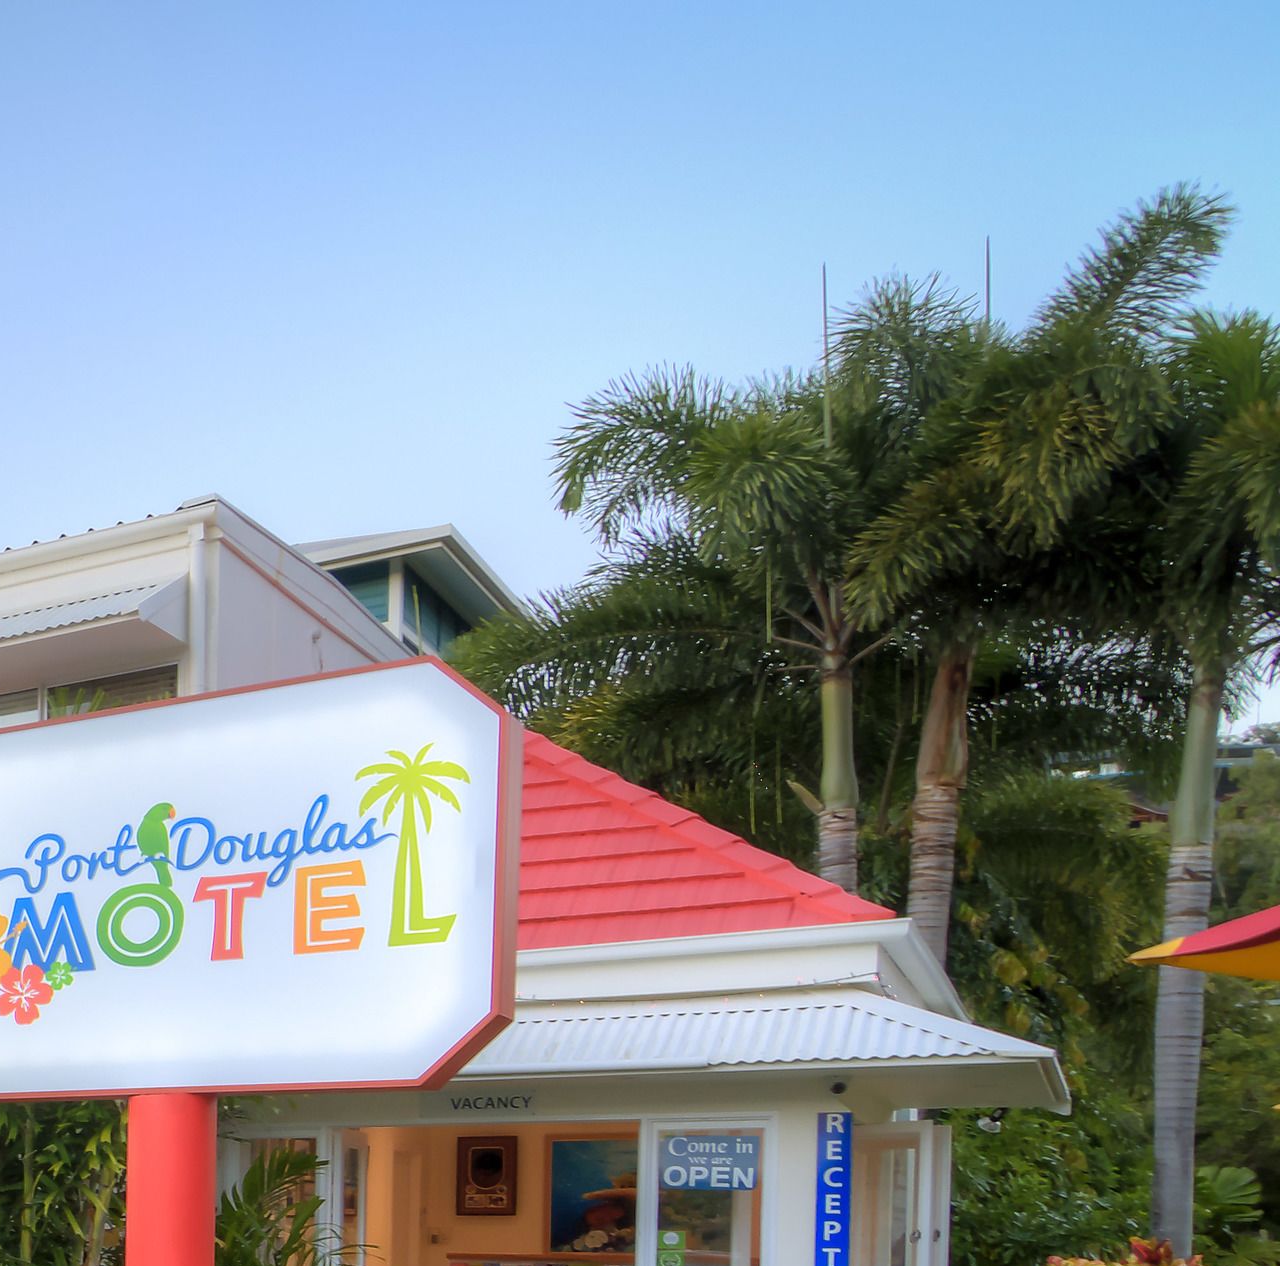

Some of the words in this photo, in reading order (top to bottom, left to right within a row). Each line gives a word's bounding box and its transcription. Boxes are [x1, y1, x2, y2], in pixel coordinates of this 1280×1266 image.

[169, 794, 397, 886] Douglas
[3, 790, 458, 972] MOTEL
[451, 1096, 532, 1110] VACANCY
[668, 1137, 728, 1156] Come
[736, 1138, 753, 1154] in
[688, 1156, 707, 1164] we
[711, 1156, 733, 1165] are
[663, 1165, 754, 1188] OPEN
